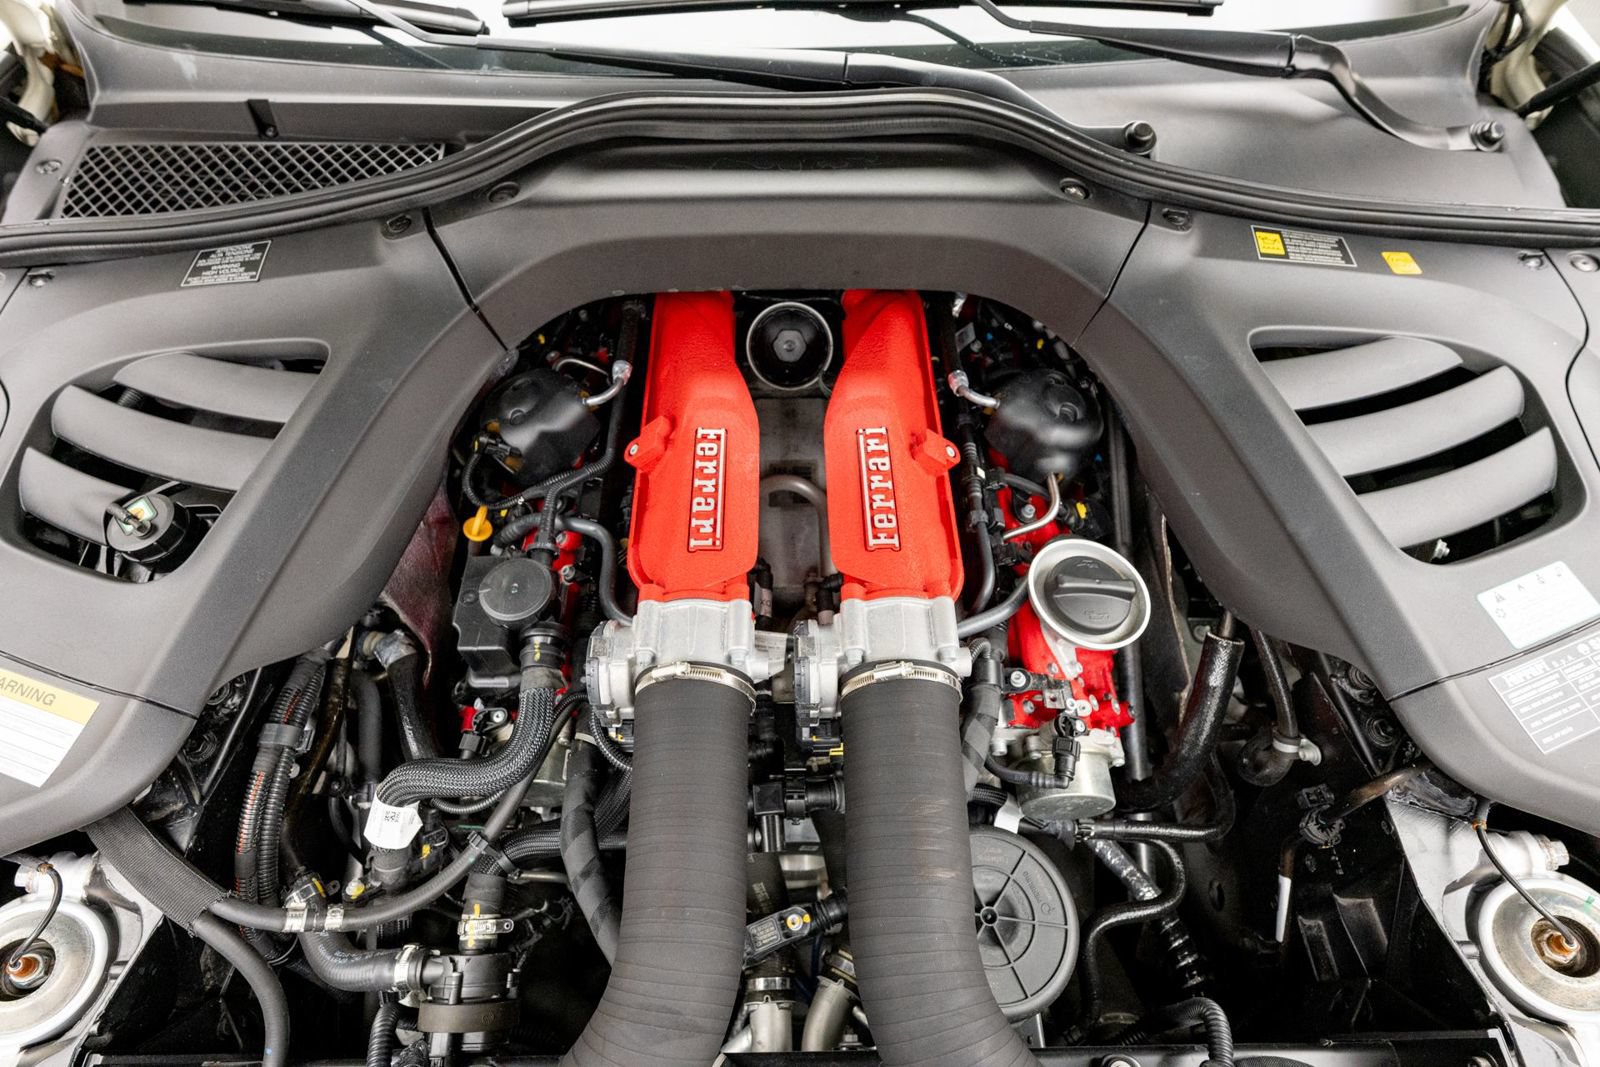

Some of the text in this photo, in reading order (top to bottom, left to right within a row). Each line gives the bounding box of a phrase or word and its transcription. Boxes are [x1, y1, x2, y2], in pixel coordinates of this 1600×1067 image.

[688, 427, 727, 548] Ferrari
[858, 427, 900, 548] Ferrari
[0, 676, 57, 707] ARNING
